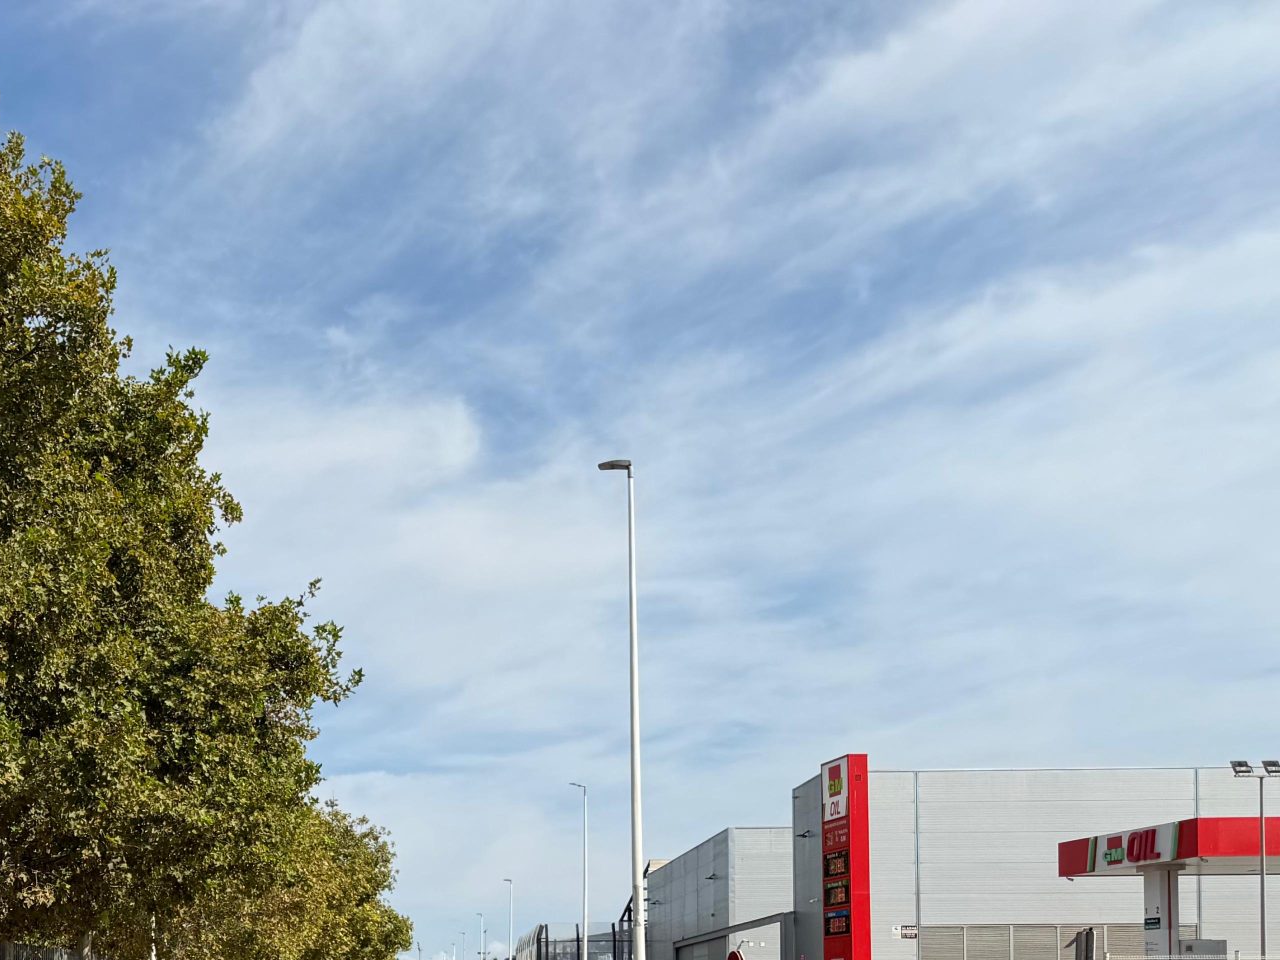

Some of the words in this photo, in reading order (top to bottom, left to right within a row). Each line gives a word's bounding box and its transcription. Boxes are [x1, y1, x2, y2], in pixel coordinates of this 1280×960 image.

[828, 778, 843, 794] GM
[830, 800, 841, 818] OIL
[1104, 848, 1125, 862] GM
[1127, 829, 1161, 863] OIL
